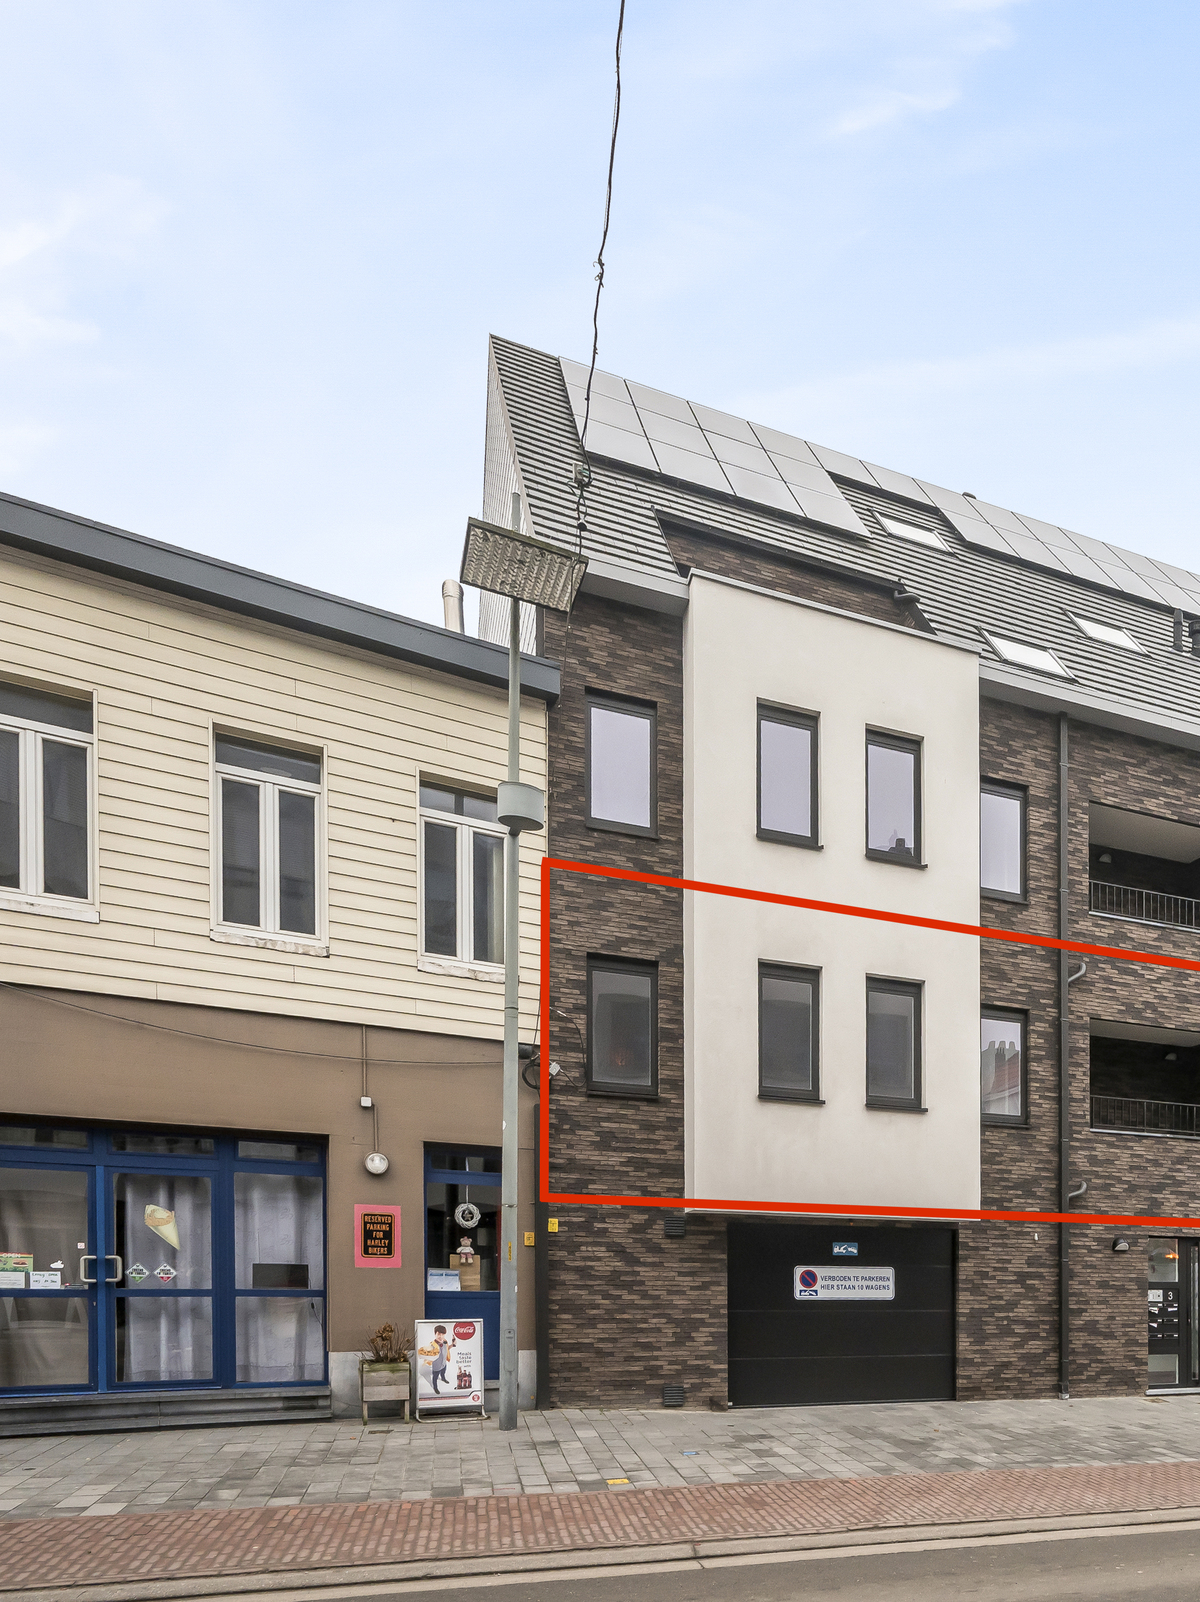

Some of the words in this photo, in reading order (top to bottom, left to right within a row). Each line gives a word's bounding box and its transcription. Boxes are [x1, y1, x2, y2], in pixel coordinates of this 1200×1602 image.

[364, 1215, 392, 1223] RESERVED
[366, 1223, 390, 1231] PARKING
[372, 1231, 384, 1239] FOR
[367, 1239, 389, 1247] HARLEY
[1167, 1291, 1173, 1300] 3
